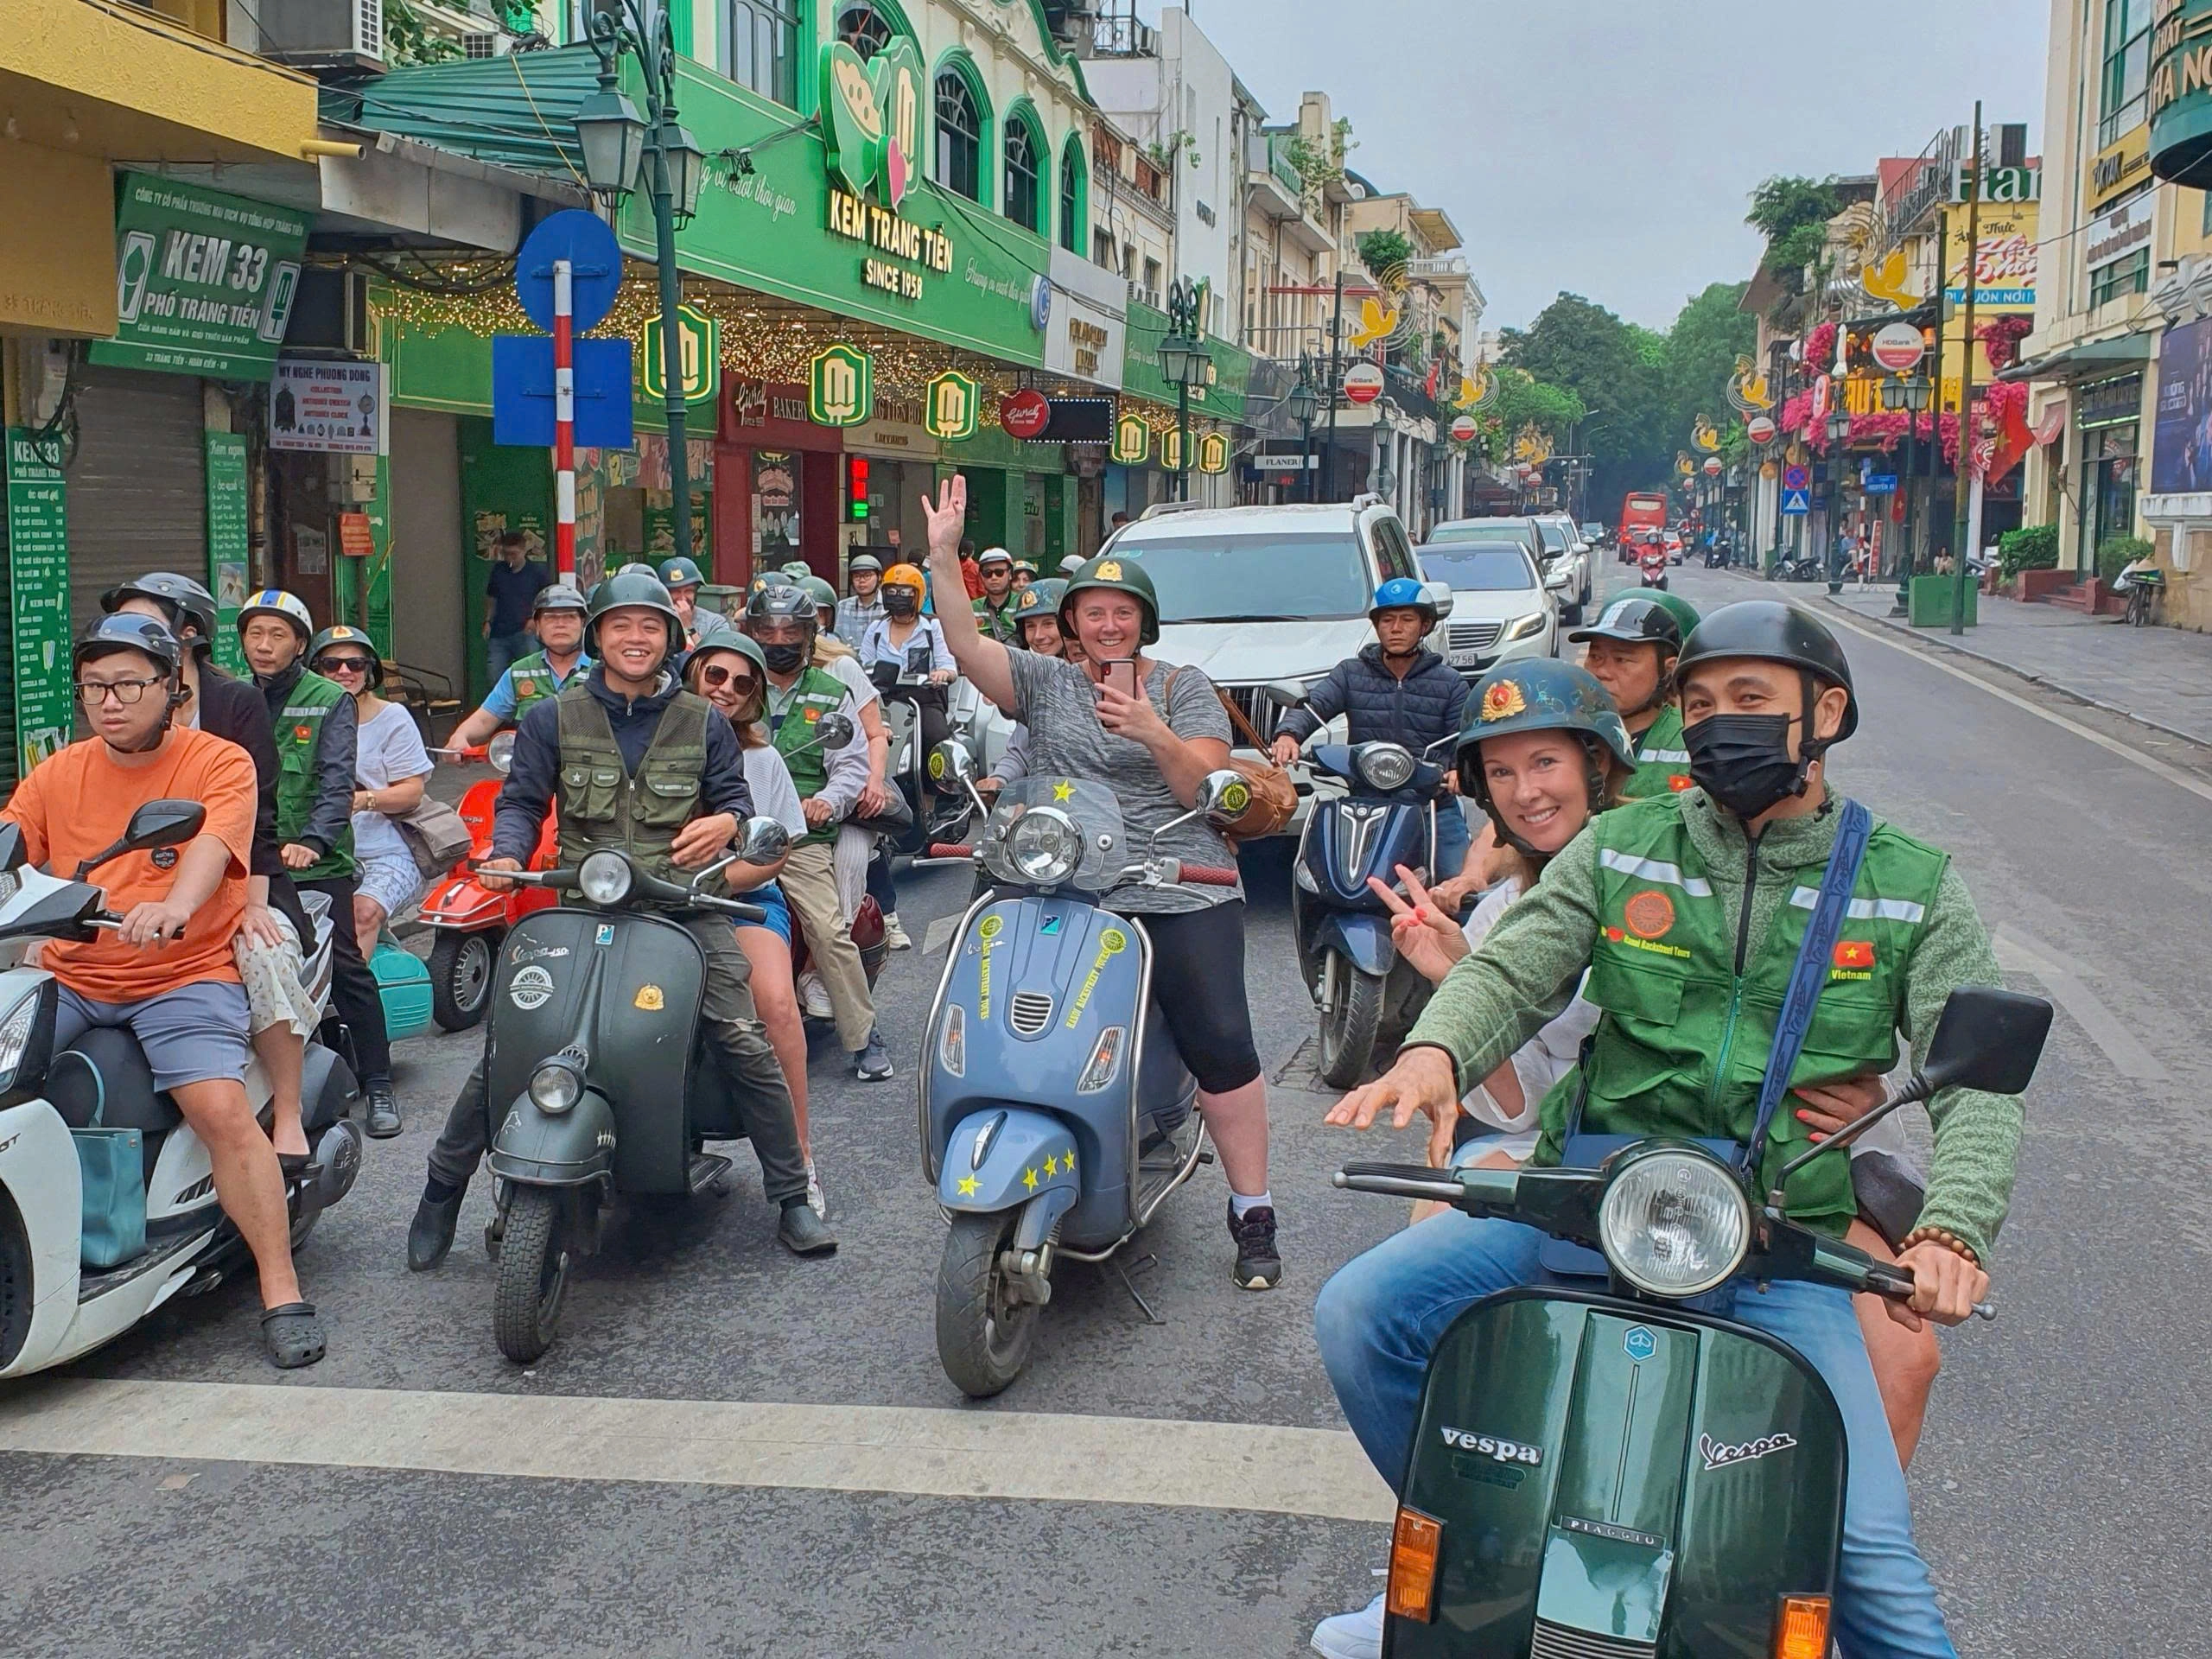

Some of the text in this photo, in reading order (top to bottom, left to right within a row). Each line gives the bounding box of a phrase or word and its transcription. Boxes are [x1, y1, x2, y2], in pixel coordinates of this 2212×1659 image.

[830, 189, 866, 241] KEM
[924, 222, 953, 273] TIỀN
[164, 230, 270, 293] KEM 33
[867, 258, 923, 300] SINCE 1958
[143, 289, 261, 329] PHỐ TRÀNG TIỀN
[14, 441, 60, 464] KEM 33
[1832, 969, 1872, 981] Vietnam
[1440, 1426, 1541, 1465] vespa
[1699, 1433, 1798, 1471] Vespa
[1570, 1519, 1656, 1547] PIAGGIO
